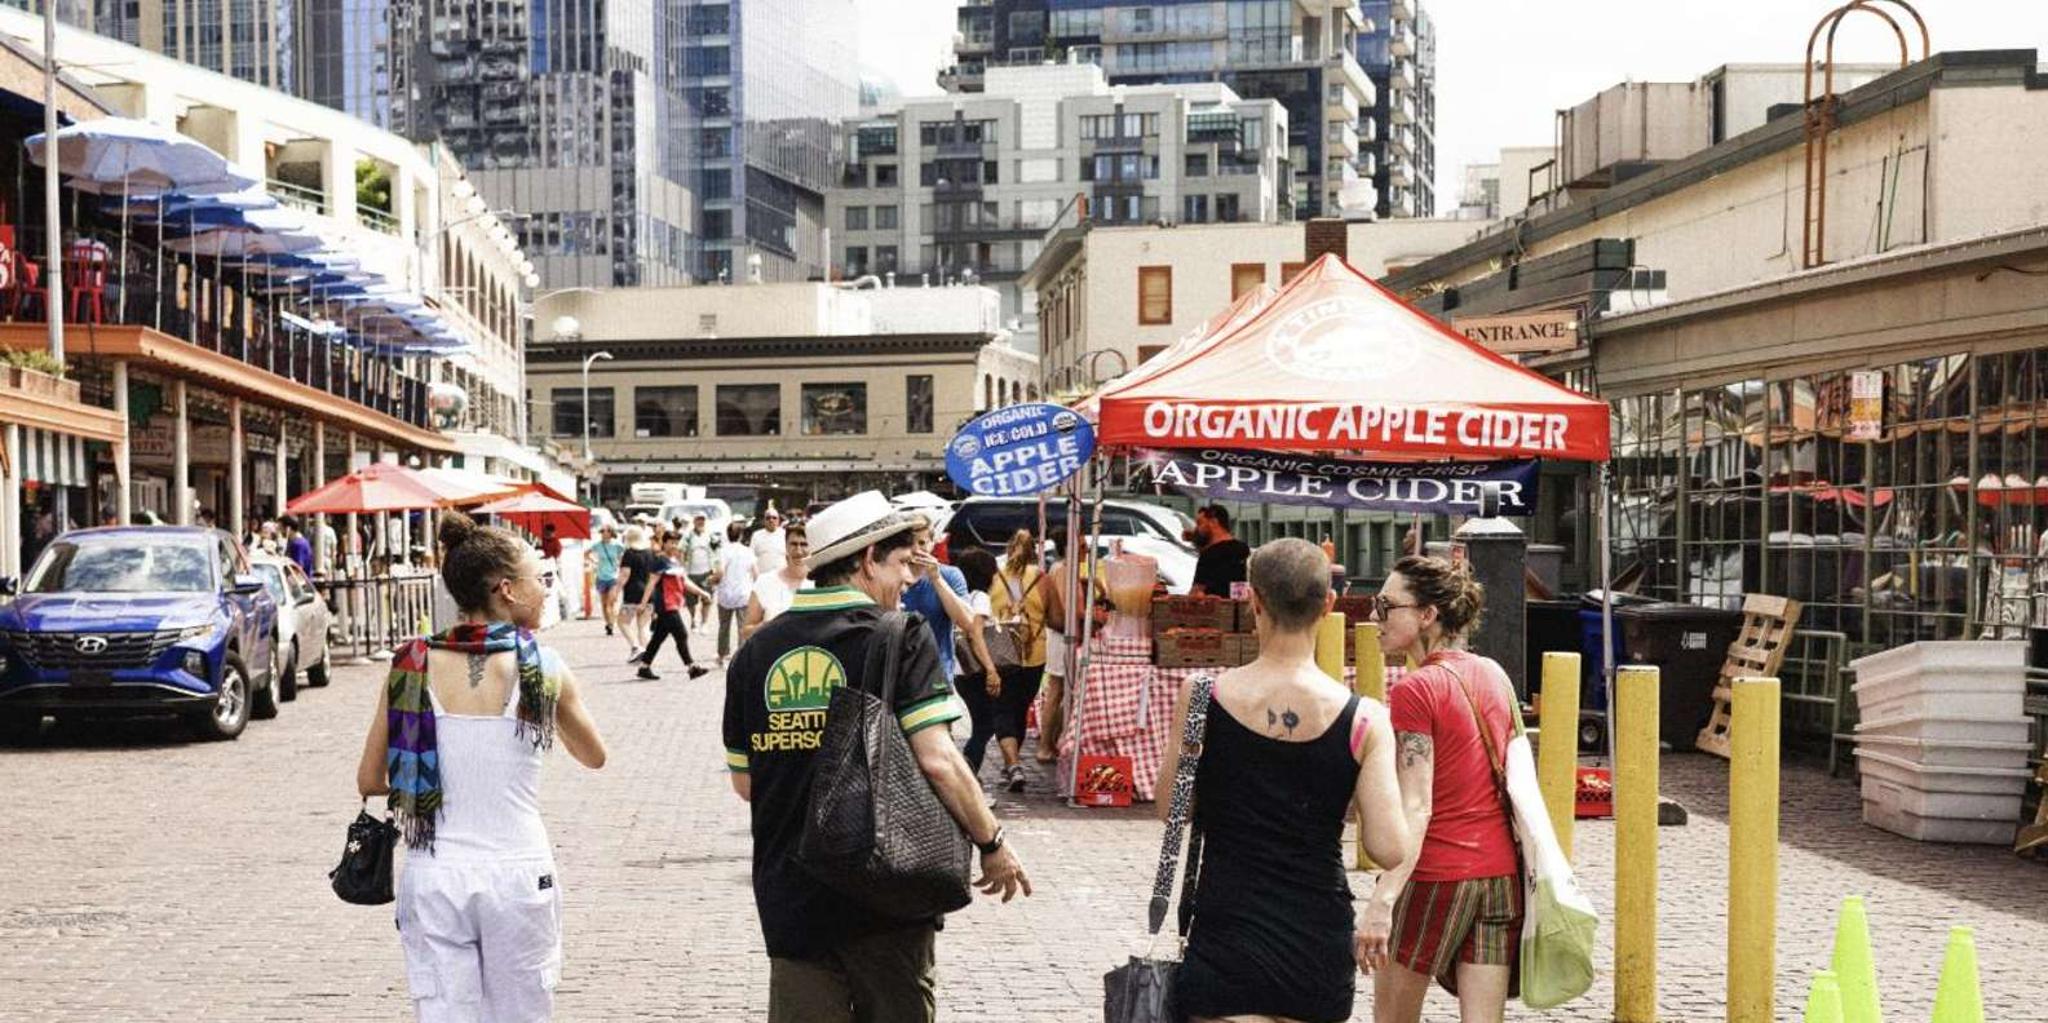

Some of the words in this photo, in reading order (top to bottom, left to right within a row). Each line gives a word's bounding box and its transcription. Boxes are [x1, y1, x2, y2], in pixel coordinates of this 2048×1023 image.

[1464, 322, 1565, 341] ENTRANCE
[981, 405, 1047, 429] ORGANIC
[1143, 401, 1322, 440] ORGANIC
[1327, 402, 1449, 445] APPLE
[1457, 409, 1569, 450] CIDER
[984, 431, 1009, 448] ICE
[1011, 422, 1048, 442] COLD
[970, 436, 1080, 479] APPLE
[1201, 449, 1314, 473] ORGANIC
[1318, 463, 1412, 478] COSMIC
[1417, 464, 1490, 477] CRISP
[971, 456, 1081, 494] CIDER
[1151, 460, 1333, 499] APPLE
[1347, 477, 1526, 507] CIDER
